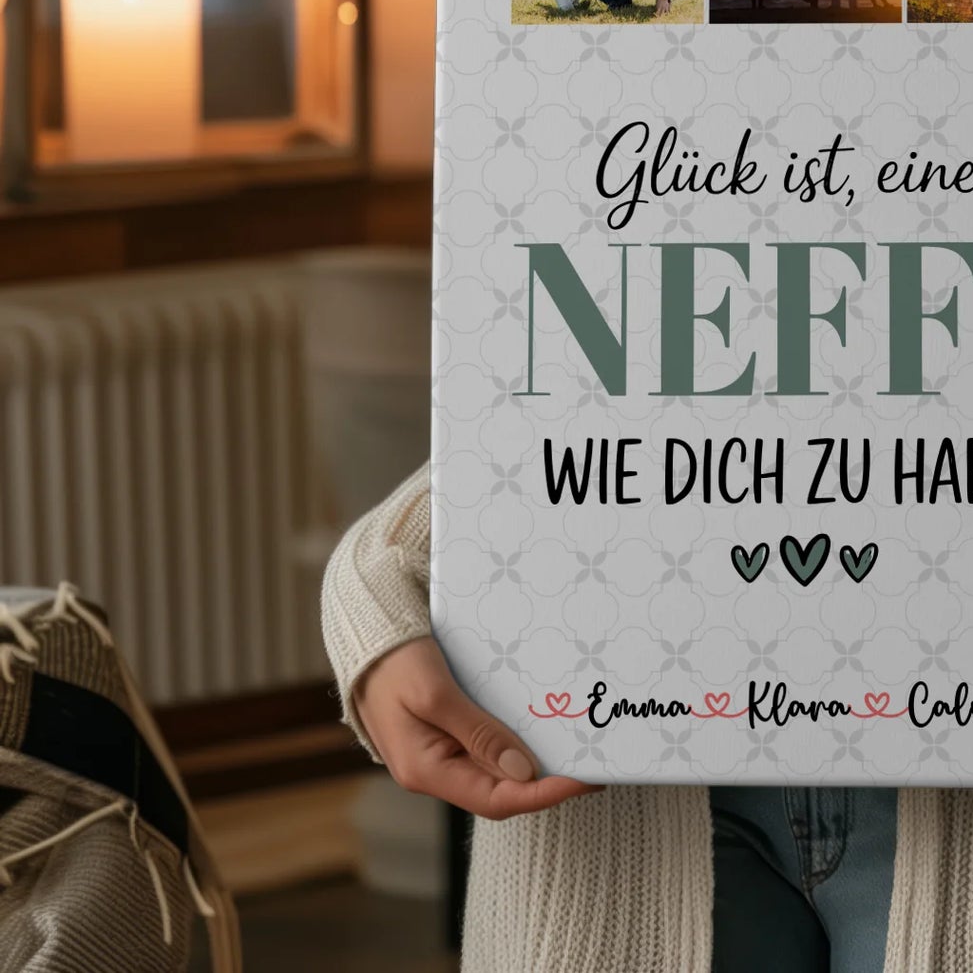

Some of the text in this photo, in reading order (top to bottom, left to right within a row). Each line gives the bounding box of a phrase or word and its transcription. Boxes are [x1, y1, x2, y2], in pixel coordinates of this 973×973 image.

[596, 121, 767, 230] Glück
[783, 134, 855, 207] ist,
[544, 437, 642, 505] WIE
[664, 438, 784, 505] DICH
[806, 438, 871, 505] ZU
[587, 680, 692, 729] Emma
[747, 680, 852, 730] Klara
